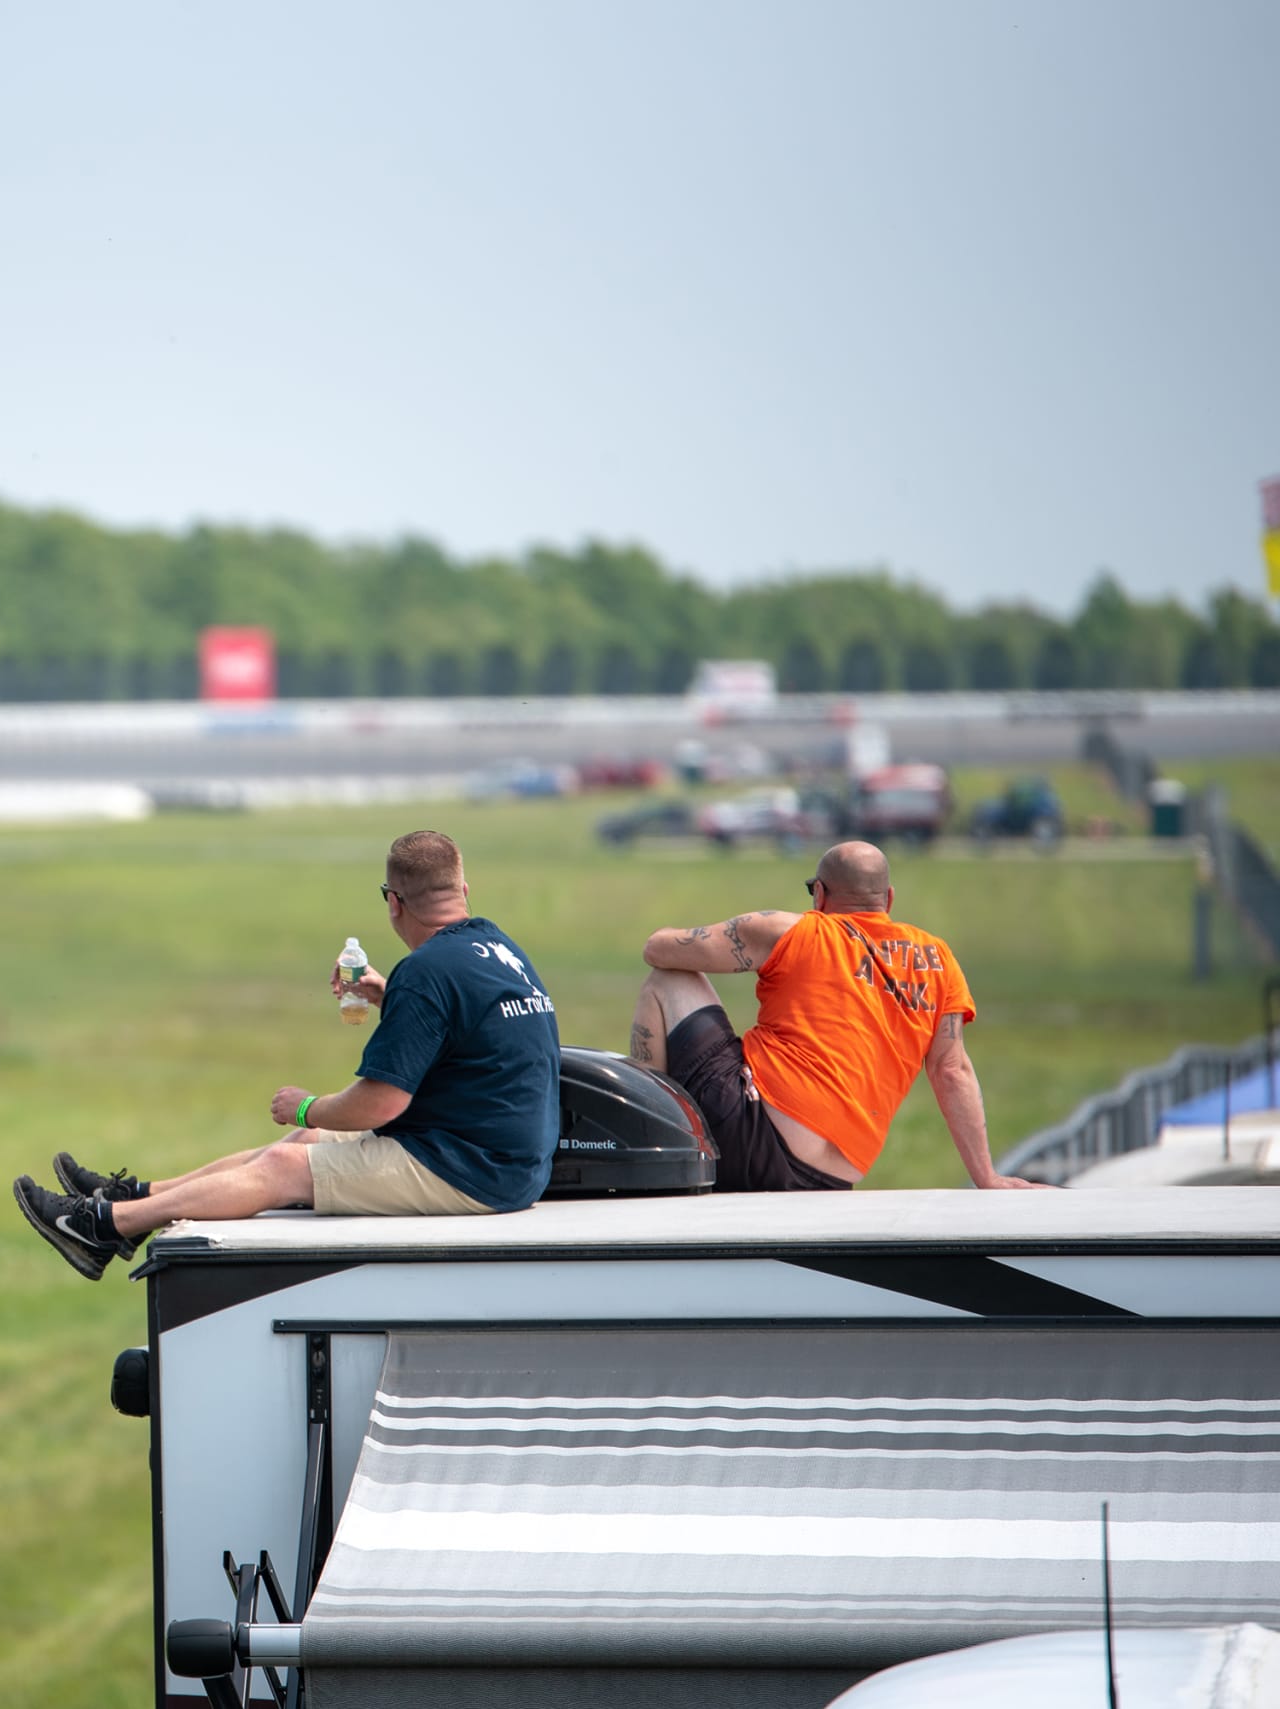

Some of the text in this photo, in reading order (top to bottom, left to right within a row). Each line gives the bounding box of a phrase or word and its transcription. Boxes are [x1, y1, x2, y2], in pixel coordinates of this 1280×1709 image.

[854, 954, 875, 987] A
[913, 943, 944, 971] BE
[571, 1139, 617, 1150] Dometic
